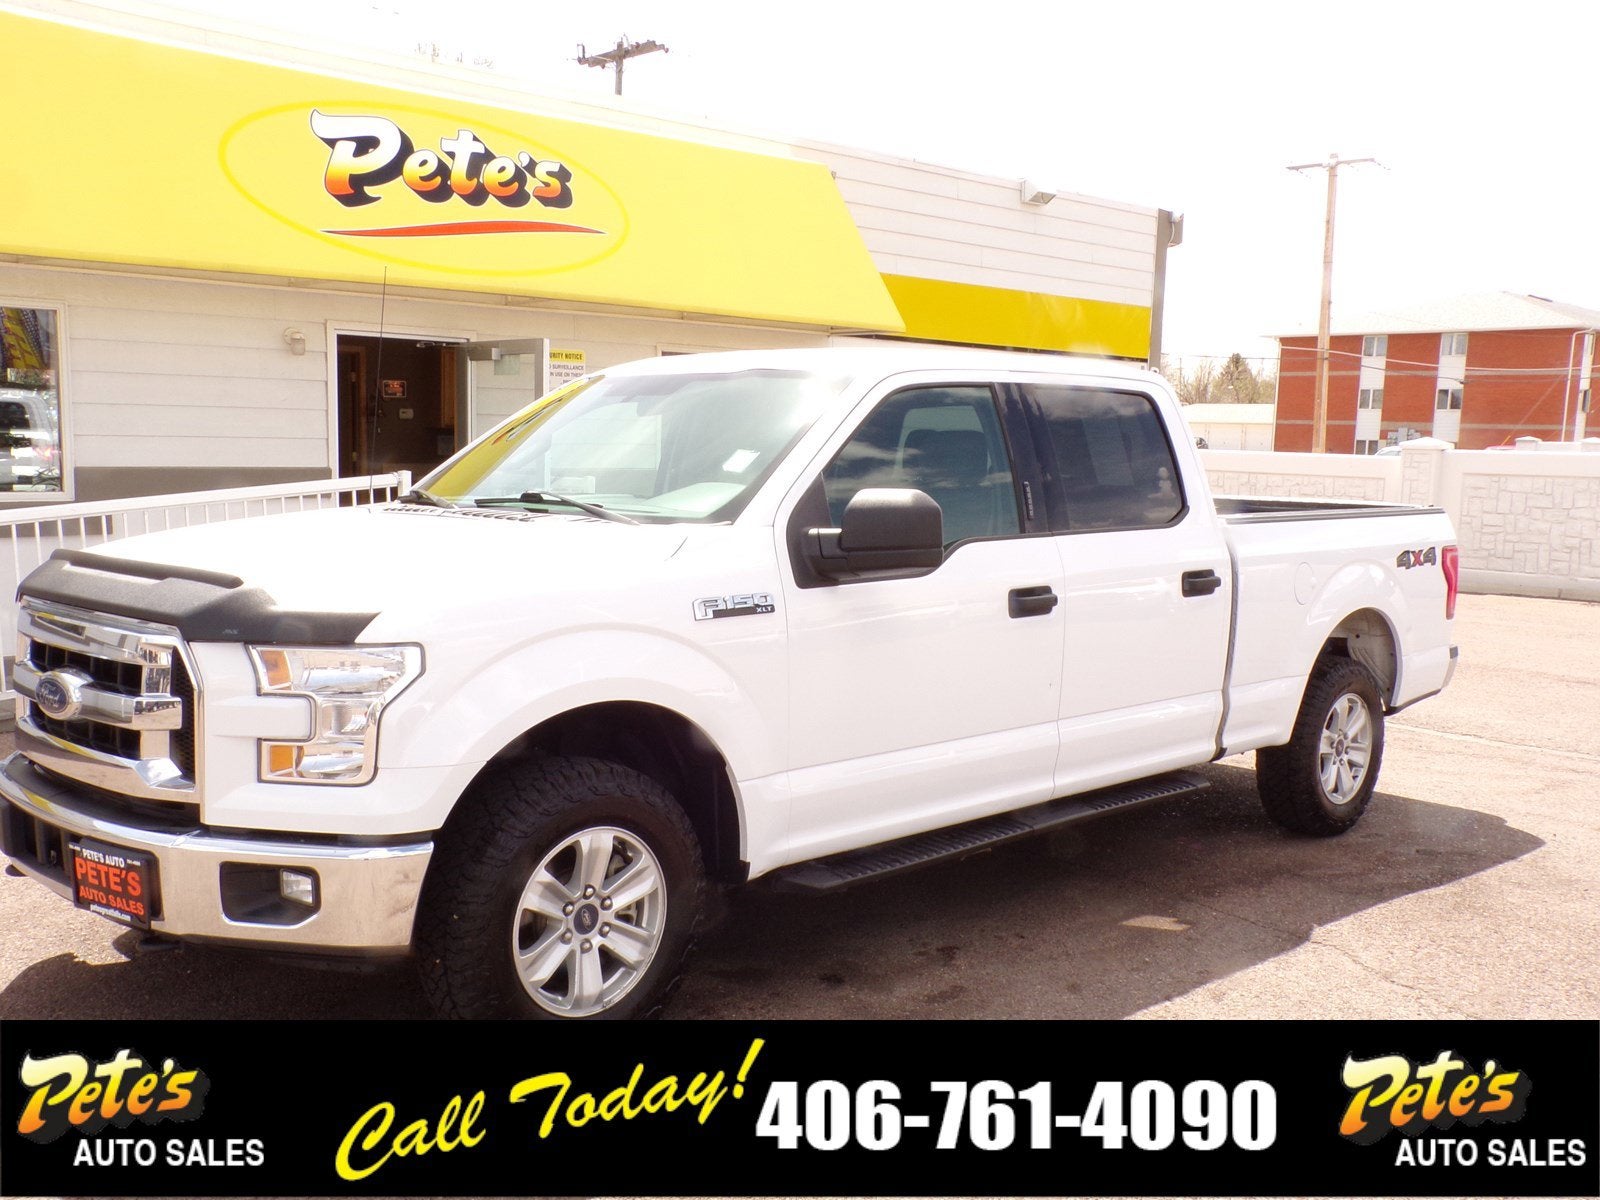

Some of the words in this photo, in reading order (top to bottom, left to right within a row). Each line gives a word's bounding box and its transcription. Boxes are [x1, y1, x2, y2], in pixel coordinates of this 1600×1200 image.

[310, 108, 573, 208] Pete's
[82, 848, 105, 863] PETE'S
[105, 855, 126, 868] AUTO
[75, 857, 142, 897] PETE'S
[79, 886, 107, 904] AUTO
[109, 895, 146, 916] SALES
